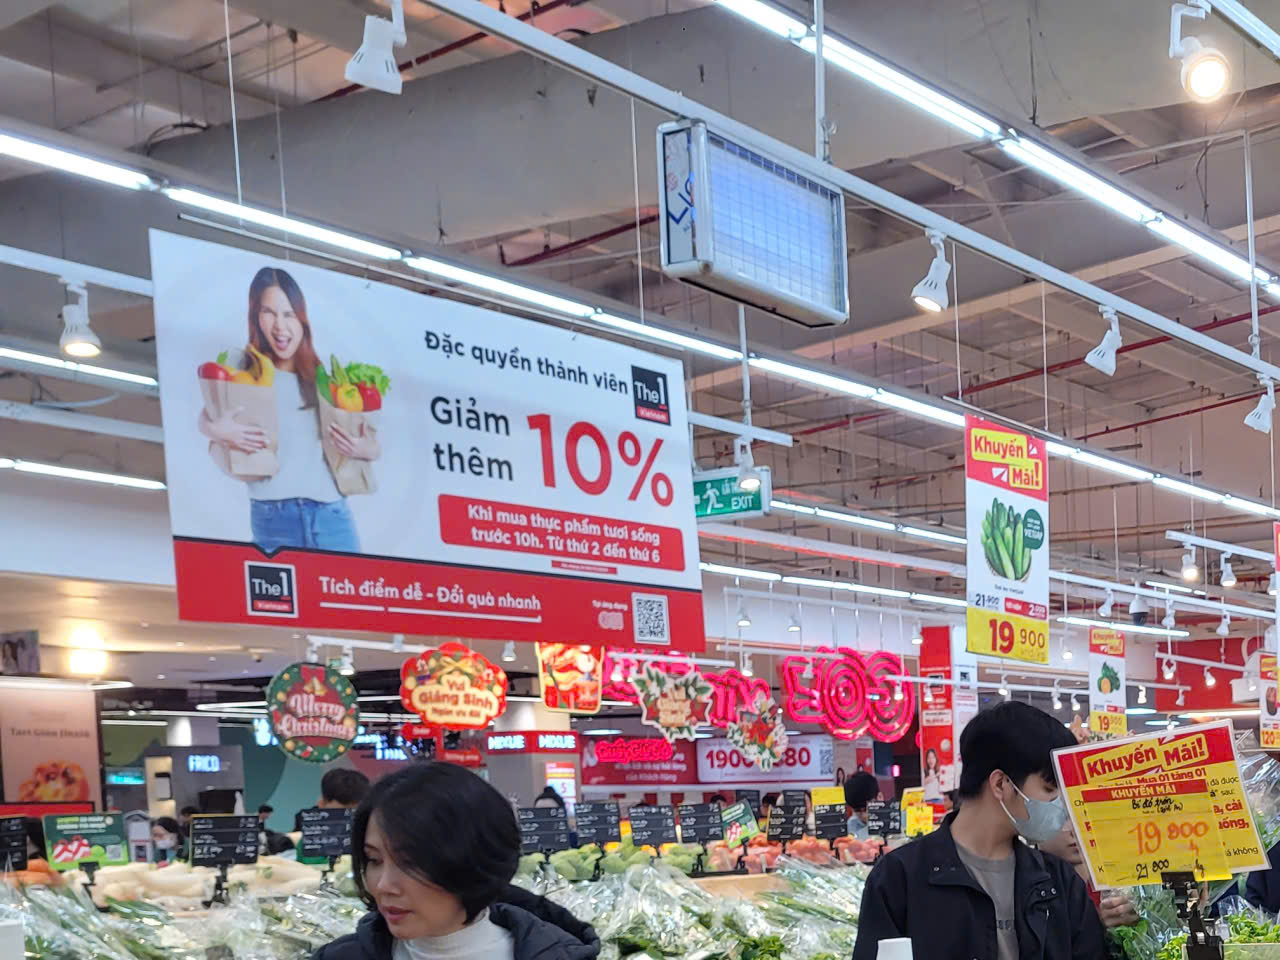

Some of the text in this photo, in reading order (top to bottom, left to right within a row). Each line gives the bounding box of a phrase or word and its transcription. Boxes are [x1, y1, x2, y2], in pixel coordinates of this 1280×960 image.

[425, 330, 628, 395] Đặc quyền thành viên
[430, 396, 510, 436] Giảm
[433, 443, 514, 481] thêm
[527, 413, 674, 507] 10%
[974, 435, 1024, 459] Khuyến
[731, 495, 754, 510] EXIT
[468, 504, 660, 546] Khi mua thực phẩm tươi sống
[471, 526, 661, 563] trước 10h. Từ thứ 2 đến thứ 6
[319, 576, 355, 597] Tích
[359, 577, 400, 599] điểm
[403, 581, 423, 601] dễ
[437, 584, 464, 604] Đổi
[467, 590, 495, 607] quà
[498, 592, 542, 610] nhanh
[989, 618, 1046, 655] 19 900
[289, 692, 346, 721] Merry
[278, 712, 356, 741] Christmas
[1098, 715, 1110, 731] 19
[1087, 743, 1157, 779] Khuyến
[1163, 737, 1206, 767] Mãi!
[1158, 772, 1170, 782] 01
[1195, 767, 1207, 777] 01
[1111, 785, 1155, 799] KHUYẾN
[1132, 799, 1141, 809] Bí
[1128, 821, 1162, 857] 19
[1233, 846, 1259, 858] không
[1136, 863, 1149, 881] 21
